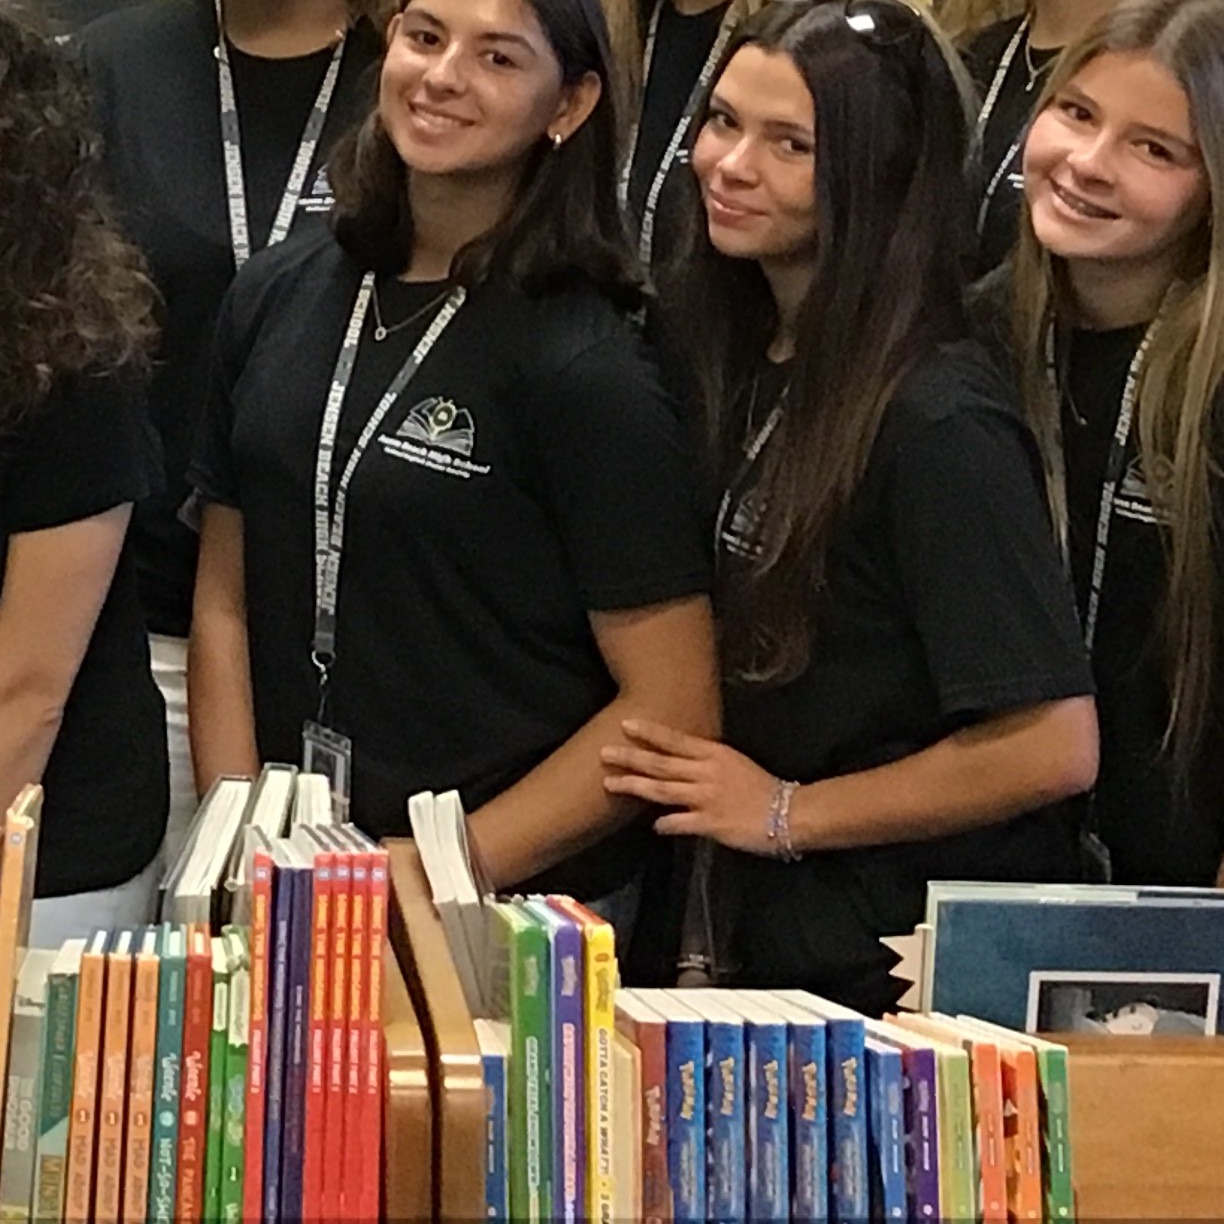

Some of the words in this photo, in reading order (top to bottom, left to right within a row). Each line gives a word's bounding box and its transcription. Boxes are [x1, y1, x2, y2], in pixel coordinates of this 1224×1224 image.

[412, 302, 458, 365] JENSEN
[321, 380, 347, 446] JENSEN
[357, 392, 398, 448] SCHOOL
[315, 449, 332, 505] BEACH
[597, 1027, 610, 1068] GOTTA
[598, 1069, 611, 1112] CATCH
[17, 1100, 33, 1152] GOOD
